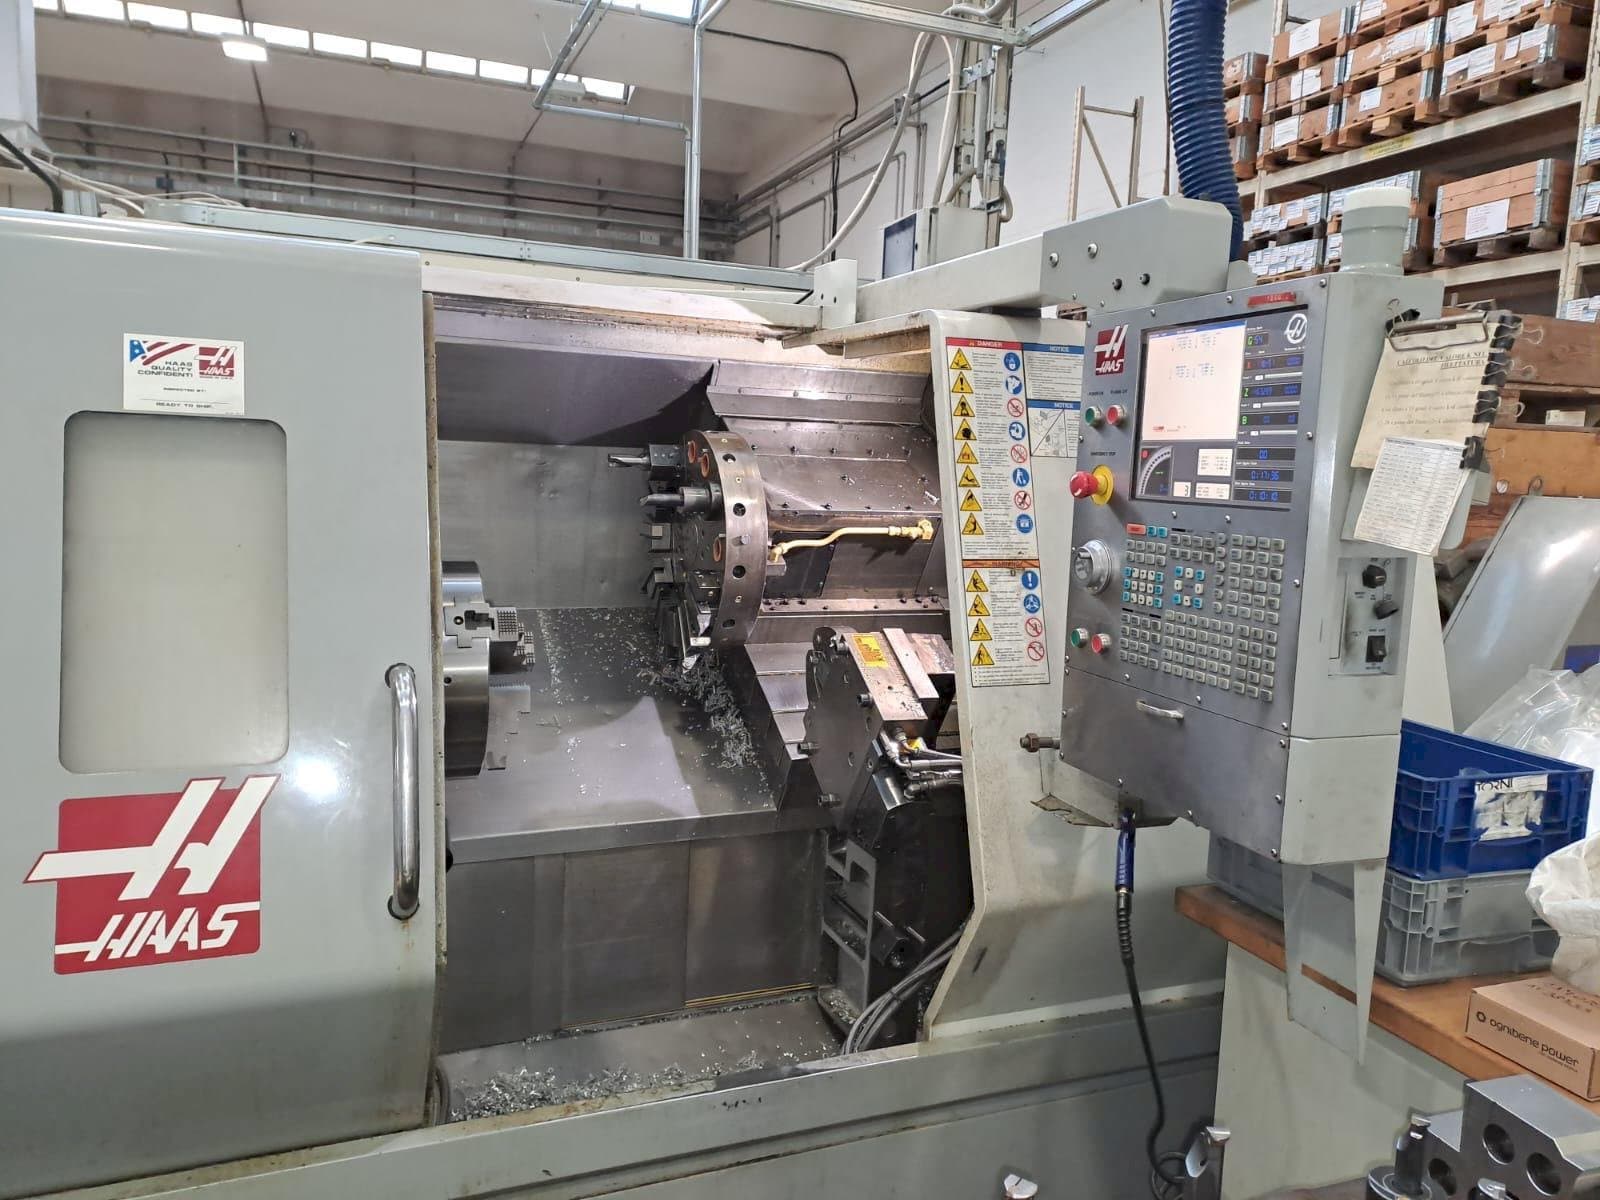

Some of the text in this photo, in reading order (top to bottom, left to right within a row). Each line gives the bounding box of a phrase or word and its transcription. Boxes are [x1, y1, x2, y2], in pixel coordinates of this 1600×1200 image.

[976, 340, 1003, 348] DANGER
[199, 367, 234, 375] HAAS
[1095, 359, 1125, 373] HAAS
[54, 901, 261, 962] HAAS
[1489, 1018, 1540, 1049] ognibene
[1541, 1043, 1580, 1067] power
